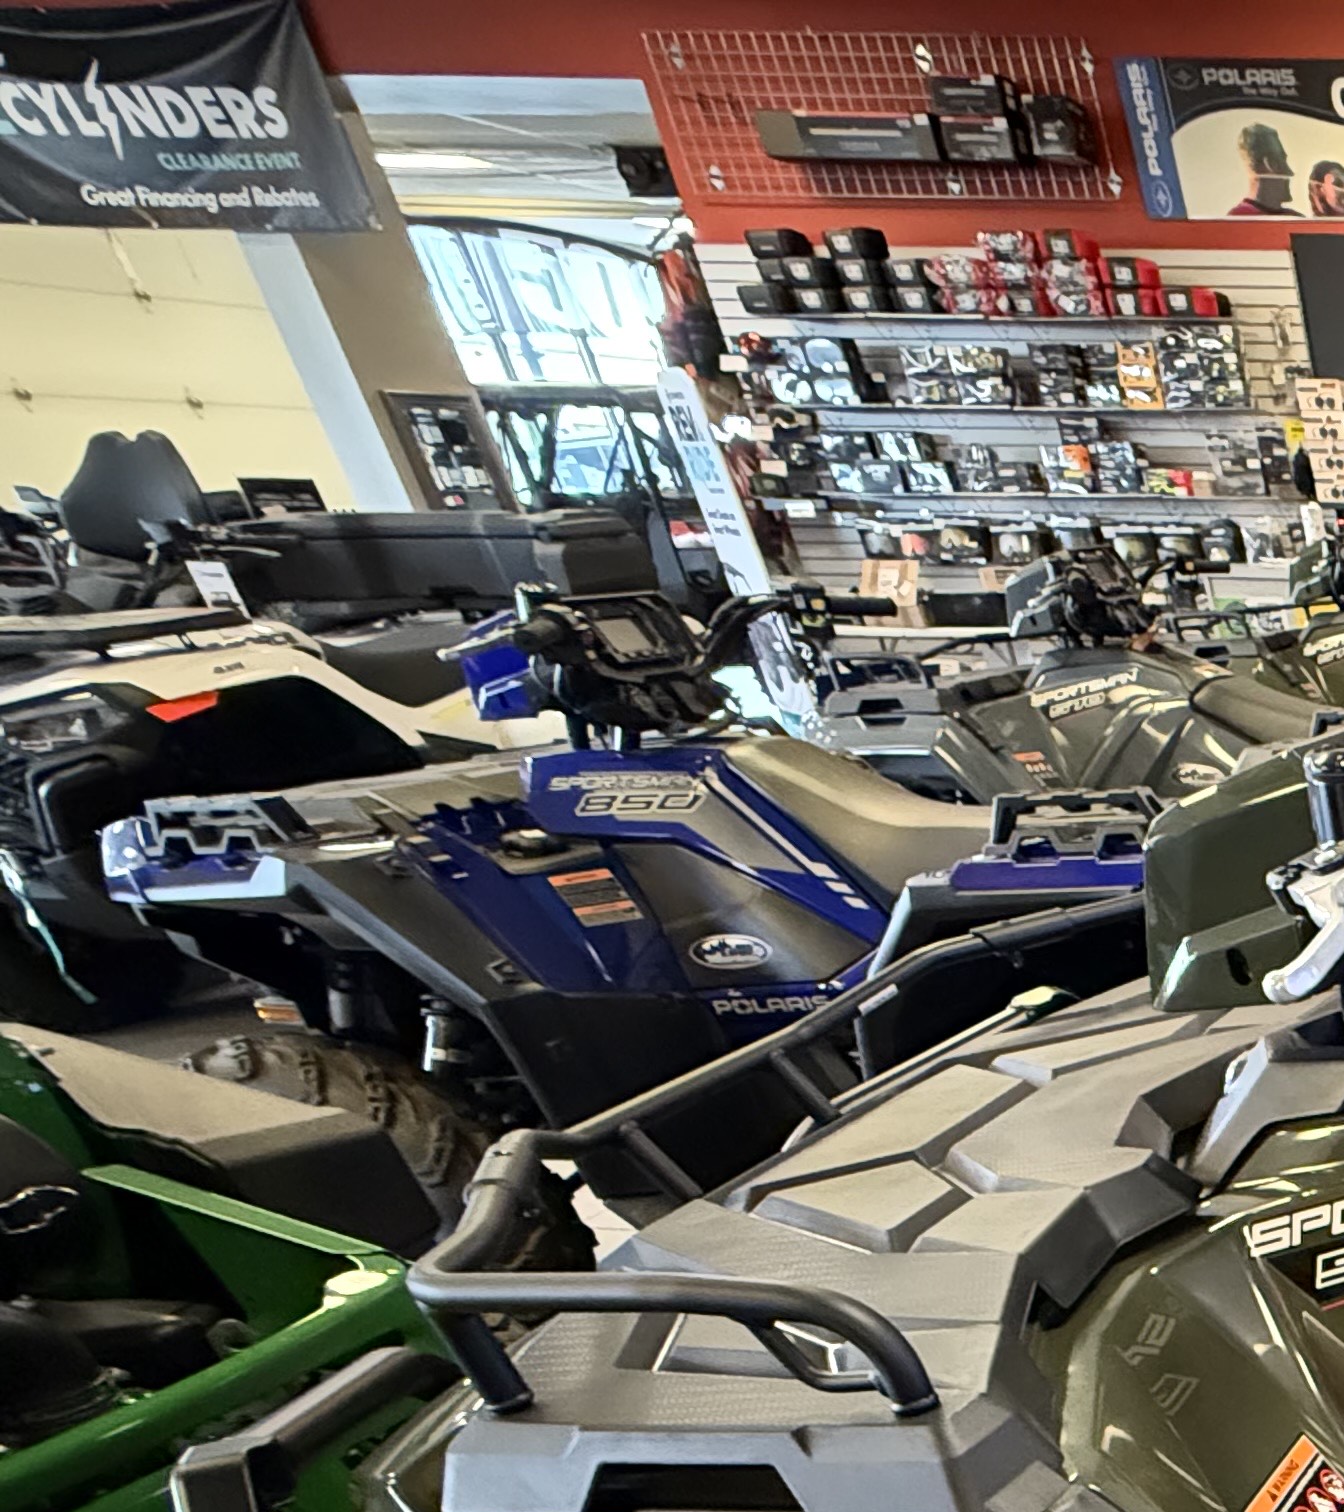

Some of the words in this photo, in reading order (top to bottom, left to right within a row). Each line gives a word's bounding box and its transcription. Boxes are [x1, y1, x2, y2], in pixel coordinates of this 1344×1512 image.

[1201, 67, 1297, 87] POLARIS
[1126, 62, 1163, 176] POLARIS
[156, 151, 256, 172] CLEARANCE
[257, 152, 303, 172] EVENT
[80, 182, 135, 208] Great
[134, 184, 218, 214] Financing
[219, 186, 251, 208] and
[253, 187, 320, 209] Rebates
[548, 775, 701, 791] SPORTSMAN
[576, 792, 705, 816] 850
[712, 994, 830, 1016] POLARIS
